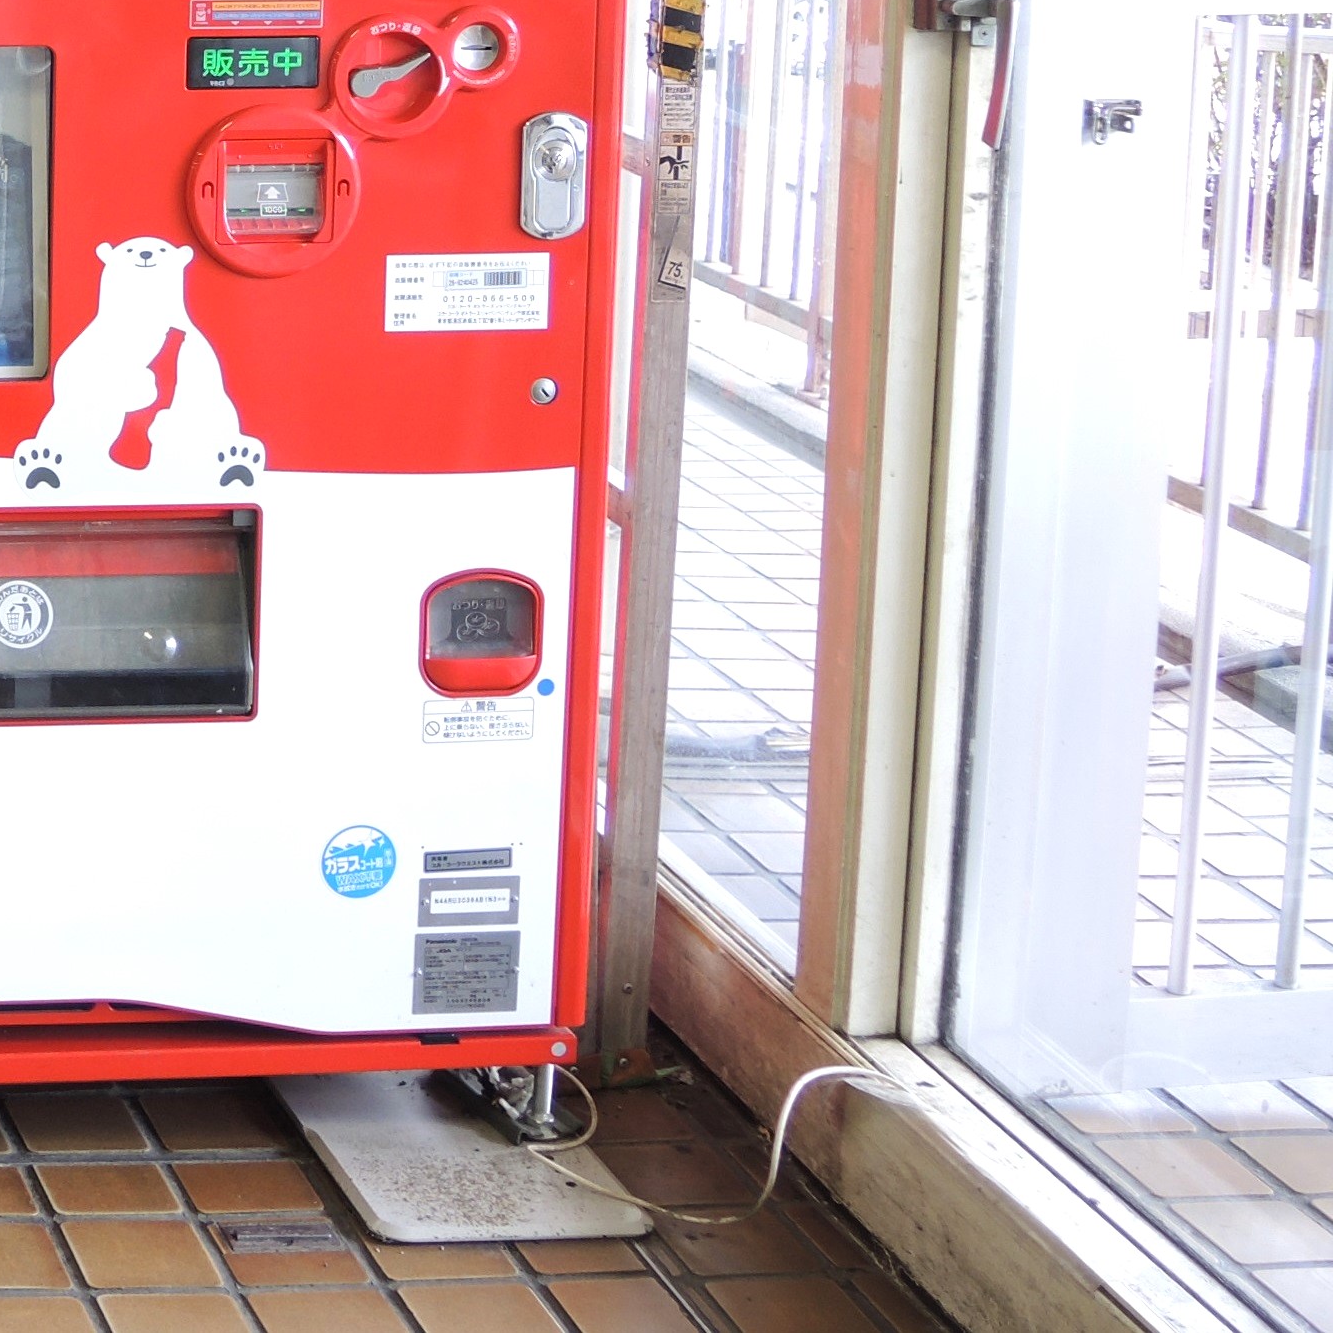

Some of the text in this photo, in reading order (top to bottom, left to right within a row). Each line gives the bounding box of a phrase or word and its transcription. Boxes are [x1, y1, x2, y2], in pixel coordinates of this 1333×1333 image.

[203, 48, 302, 77] 販売中
[0, 626, 43, 643] リサイクル
